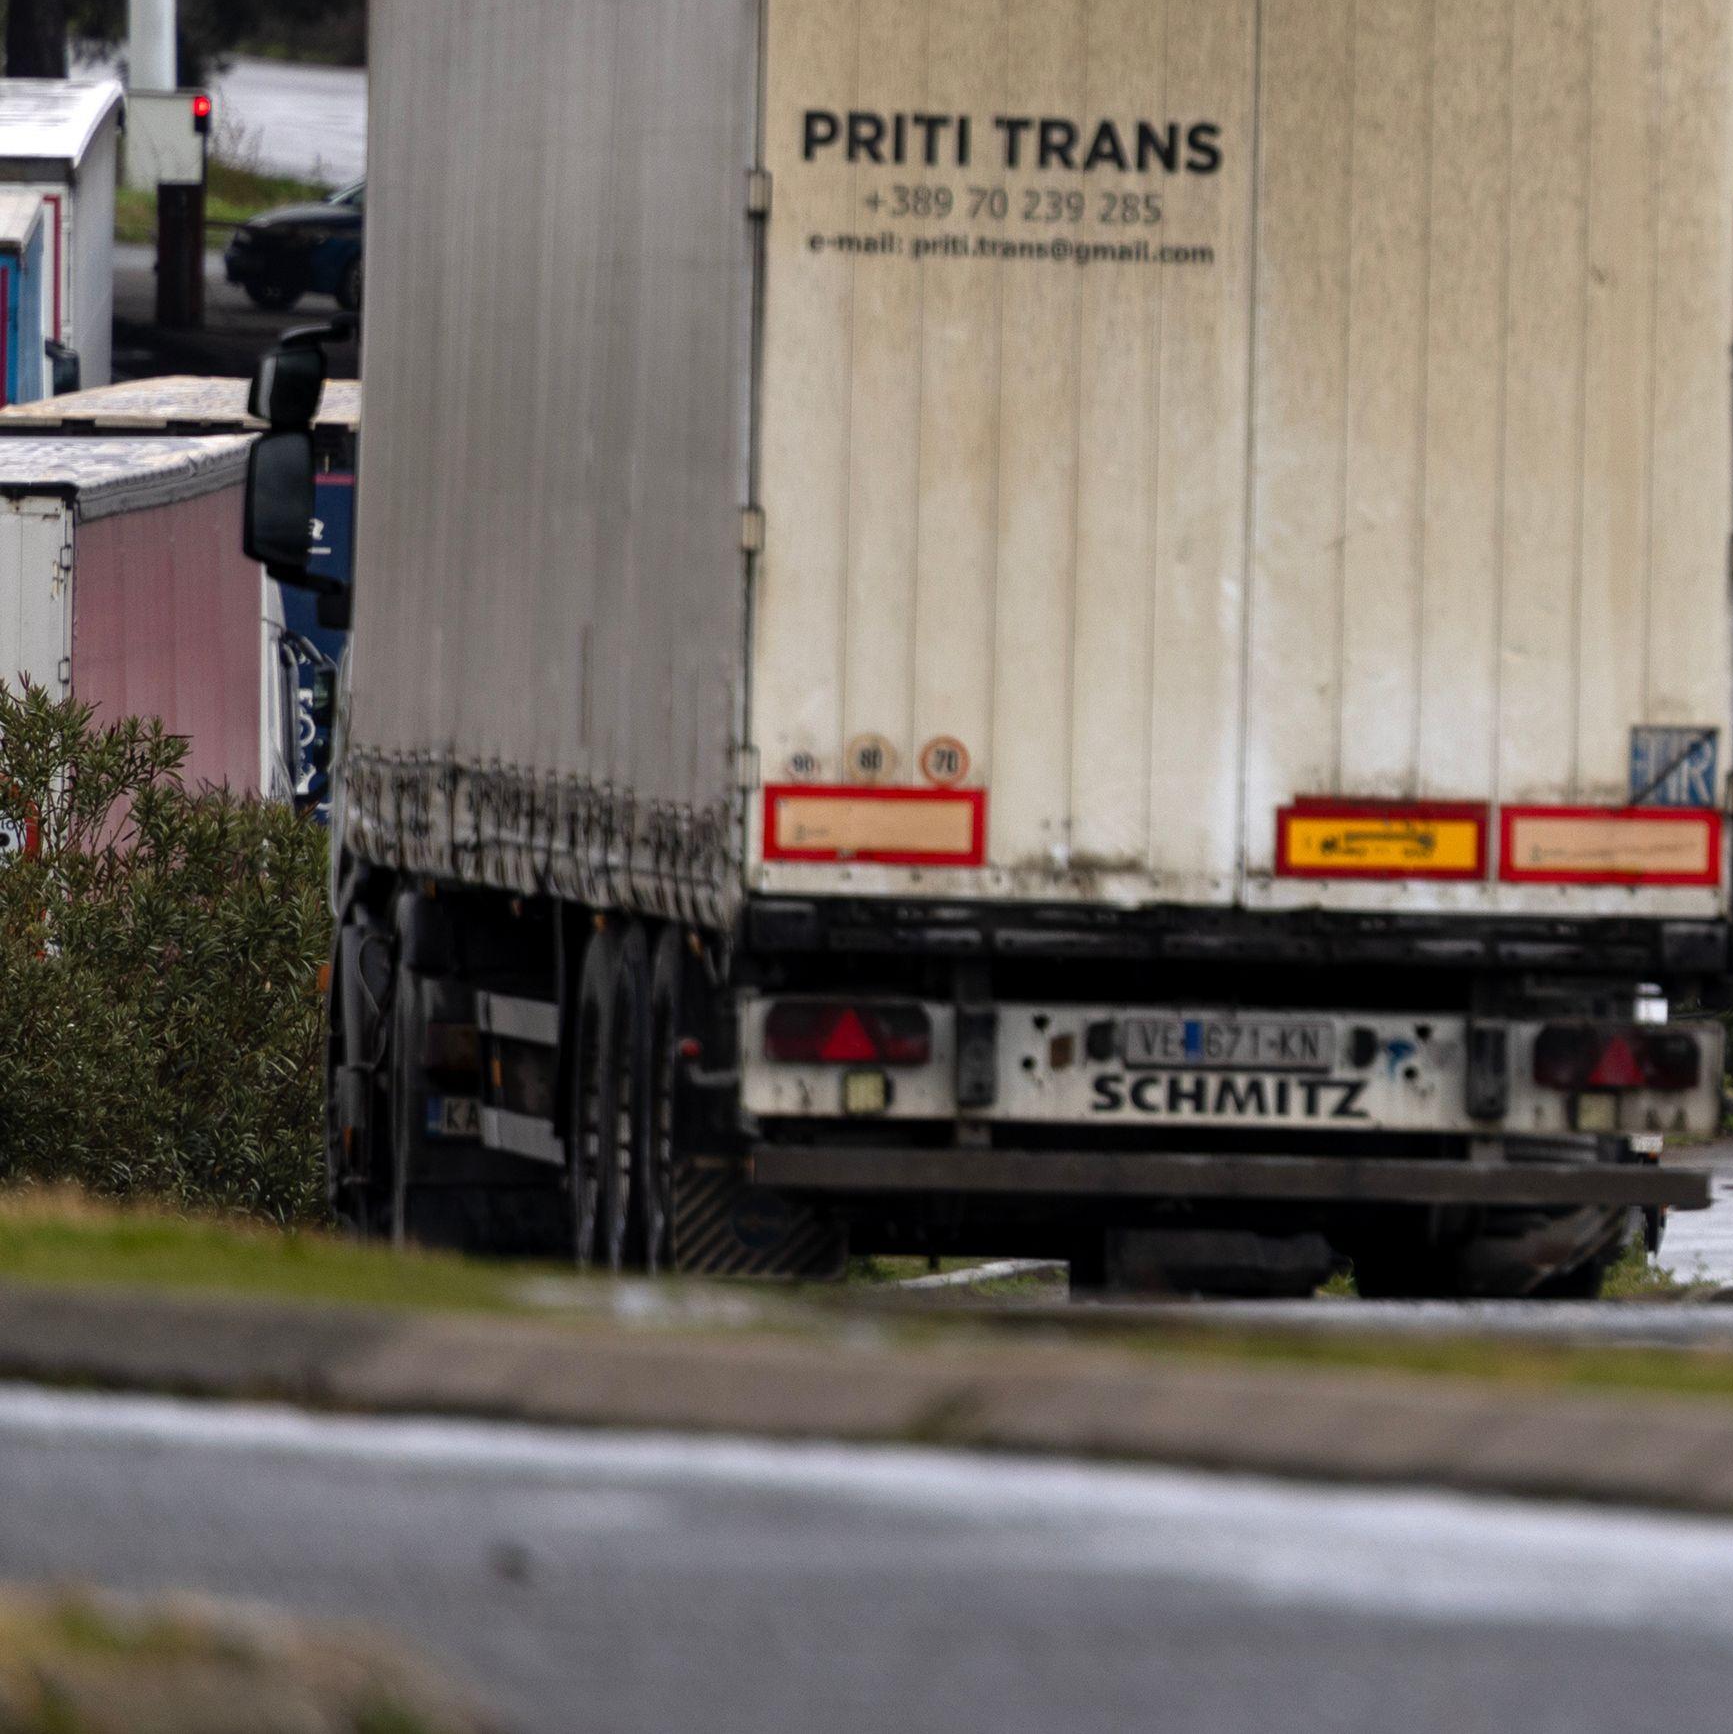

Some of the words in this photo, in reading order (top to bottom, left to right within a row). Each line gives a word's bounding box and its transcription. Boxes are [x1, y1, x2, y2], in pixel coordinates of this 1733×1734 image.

[802, 111, 971, 167] PRITI
[994, 118, 1223, 175] TRANS
[864, 184, 953, 219] +389
[967, 187, 1008, 219] 70
[1021, 189, 1085, 222] 239
[1098, 191, 1163, 226] 285
[808, 231, 905, 255] e-mail:
[911, 232, 1215, 266] priti.trans@gmail.com
[1092, 1074, 1369, 1119] SCHMITZ
